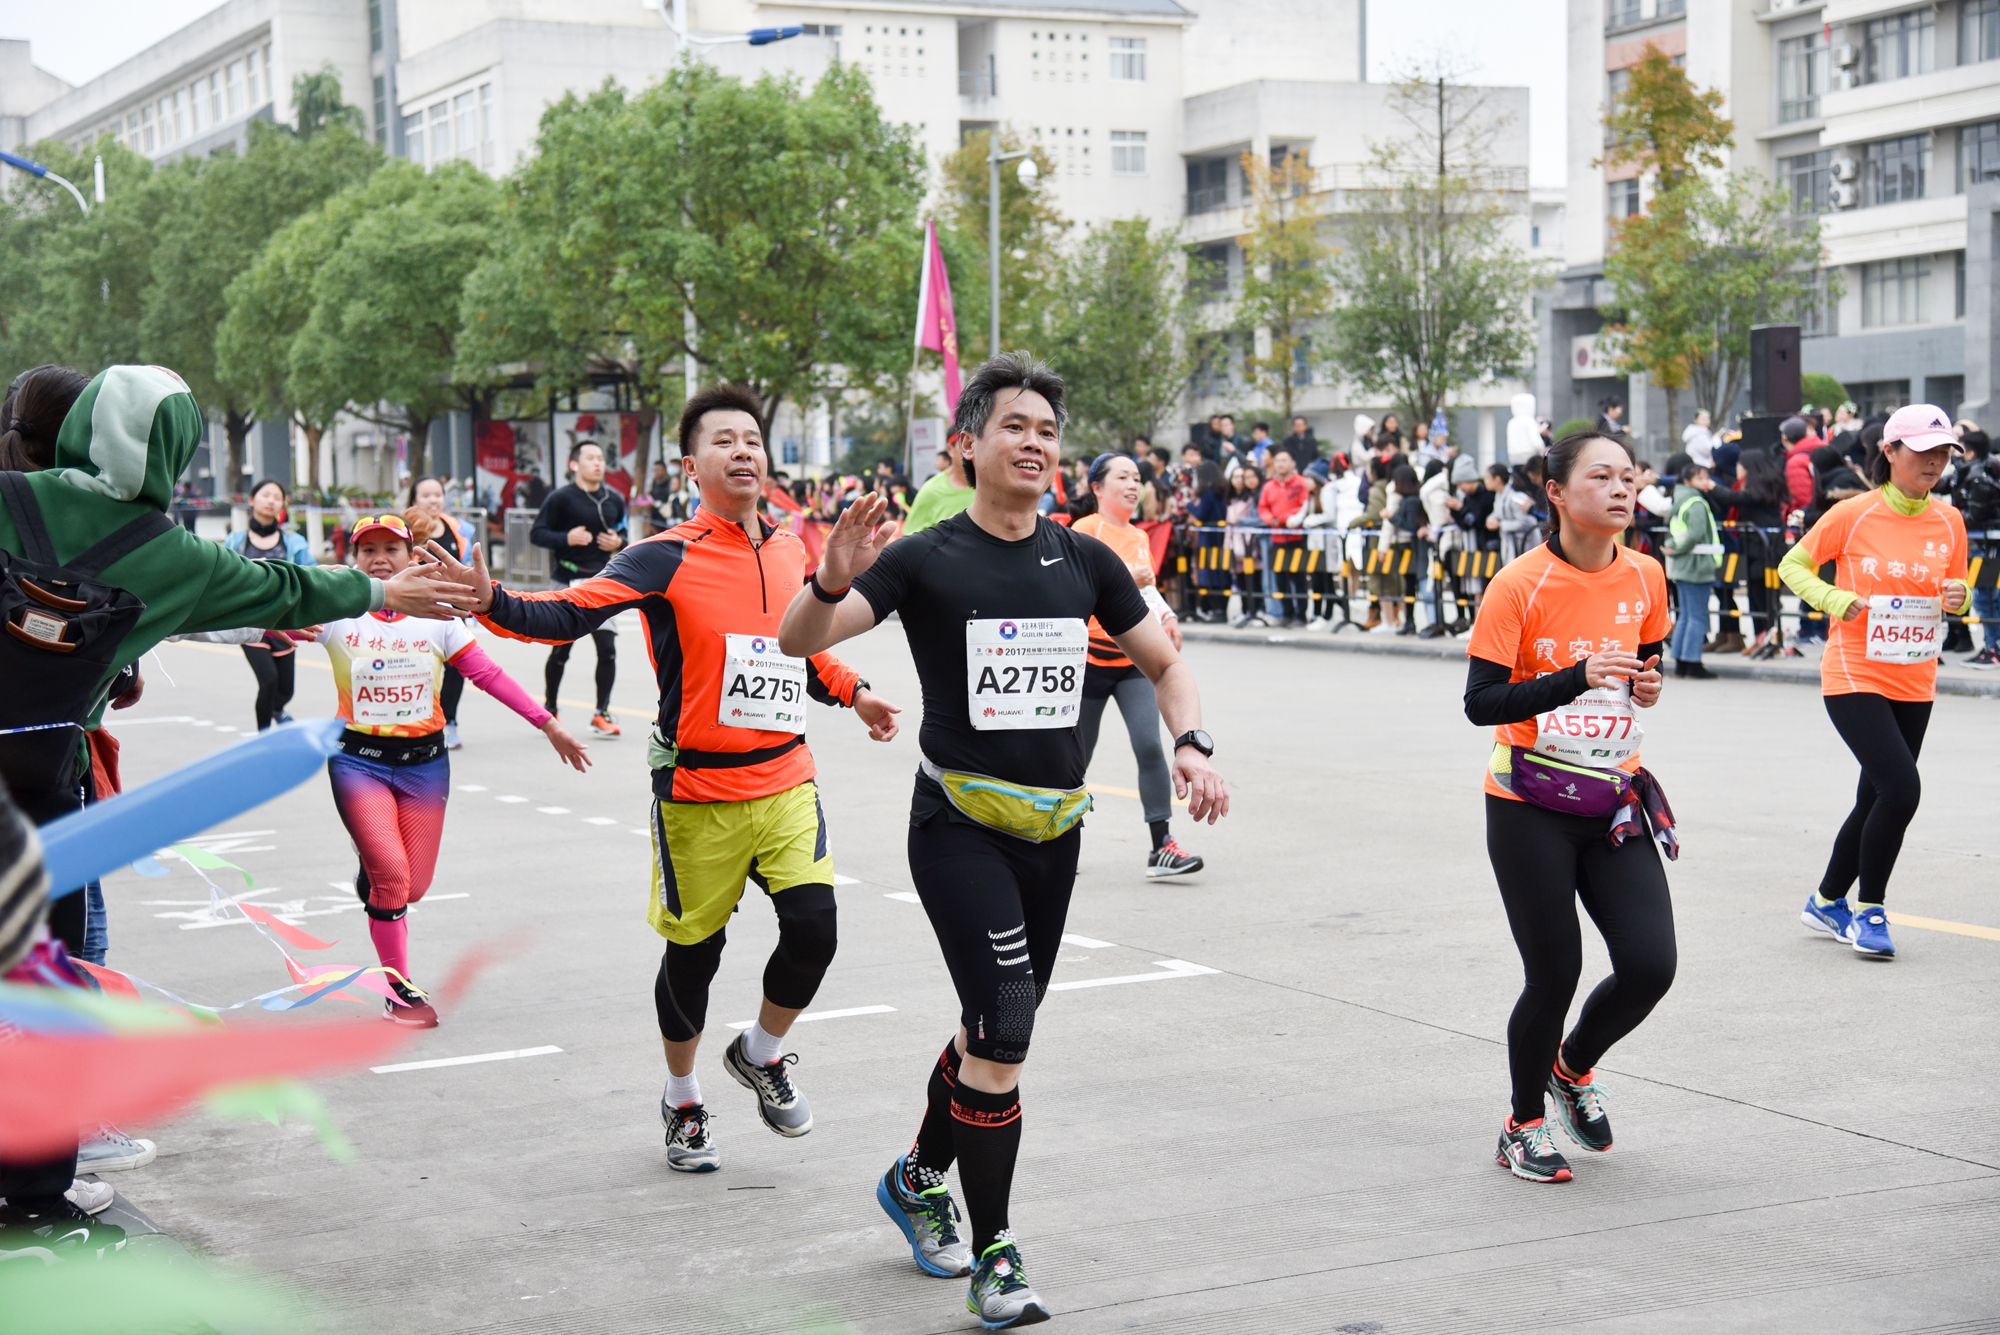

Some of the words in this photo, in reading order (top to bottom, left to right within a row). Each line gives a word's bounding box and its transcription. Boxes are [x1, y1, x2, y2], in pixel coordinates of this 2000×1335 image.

[1861, 557, 1929, 582] 霞客行
[1021, 622, 1053, 630] 桂林银行
[1870, 625, 1934, 643] A5454
[346, 631, 430, 653] 桂林跑吧
[1005, 648, 1026, 656] 2017
[755, 660, 772, 668] 2017
[727, 673, 800, 704] A2757
[975, 665, 1075, 694] A2758
[357, 684, 424, 703] A5557
[1543, 713, 1632, 740] A5577
[359, 747, 382, 758] URG
[1558, 747, 1581, 755] HUAWEI
